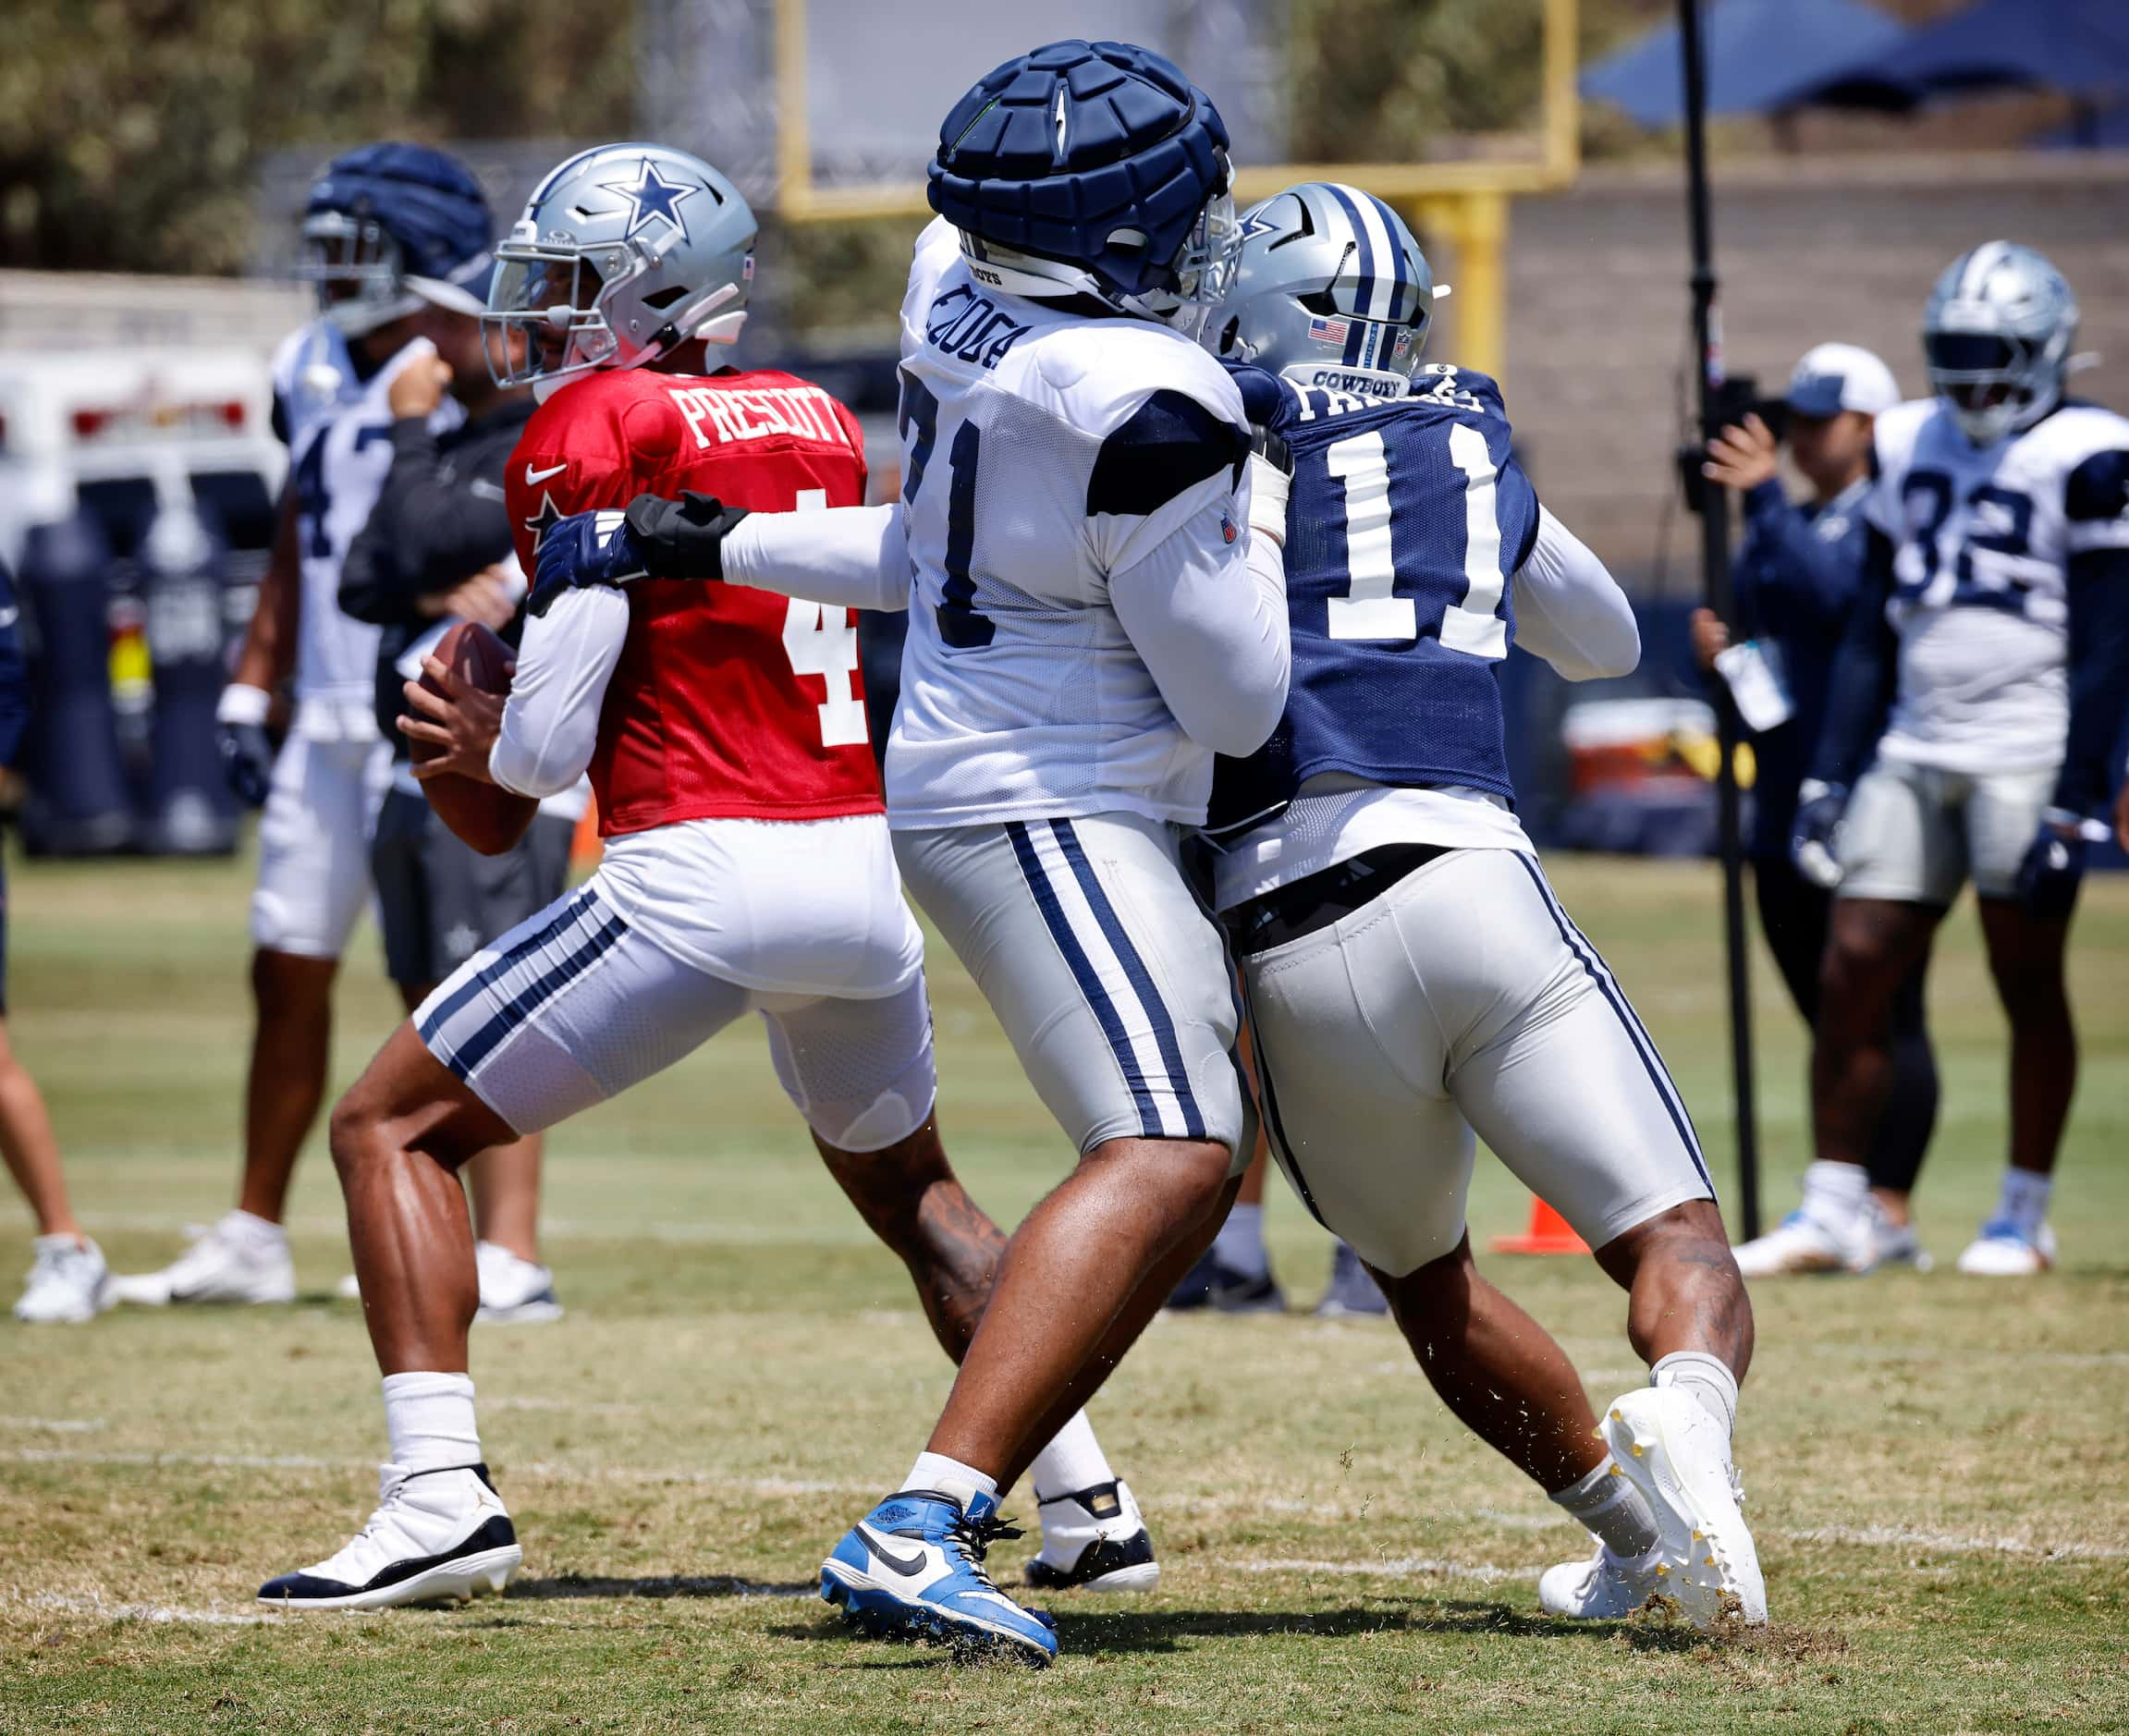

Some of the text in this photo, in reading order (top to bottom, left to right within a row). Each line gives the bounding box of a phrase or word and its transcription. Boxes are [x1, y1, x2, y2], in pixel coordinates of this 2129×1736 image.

[668, 385, 851, 450] PRESCOTT
[782, 488, 869, 747] 4
[1327, 422, 1509, 658] 11
